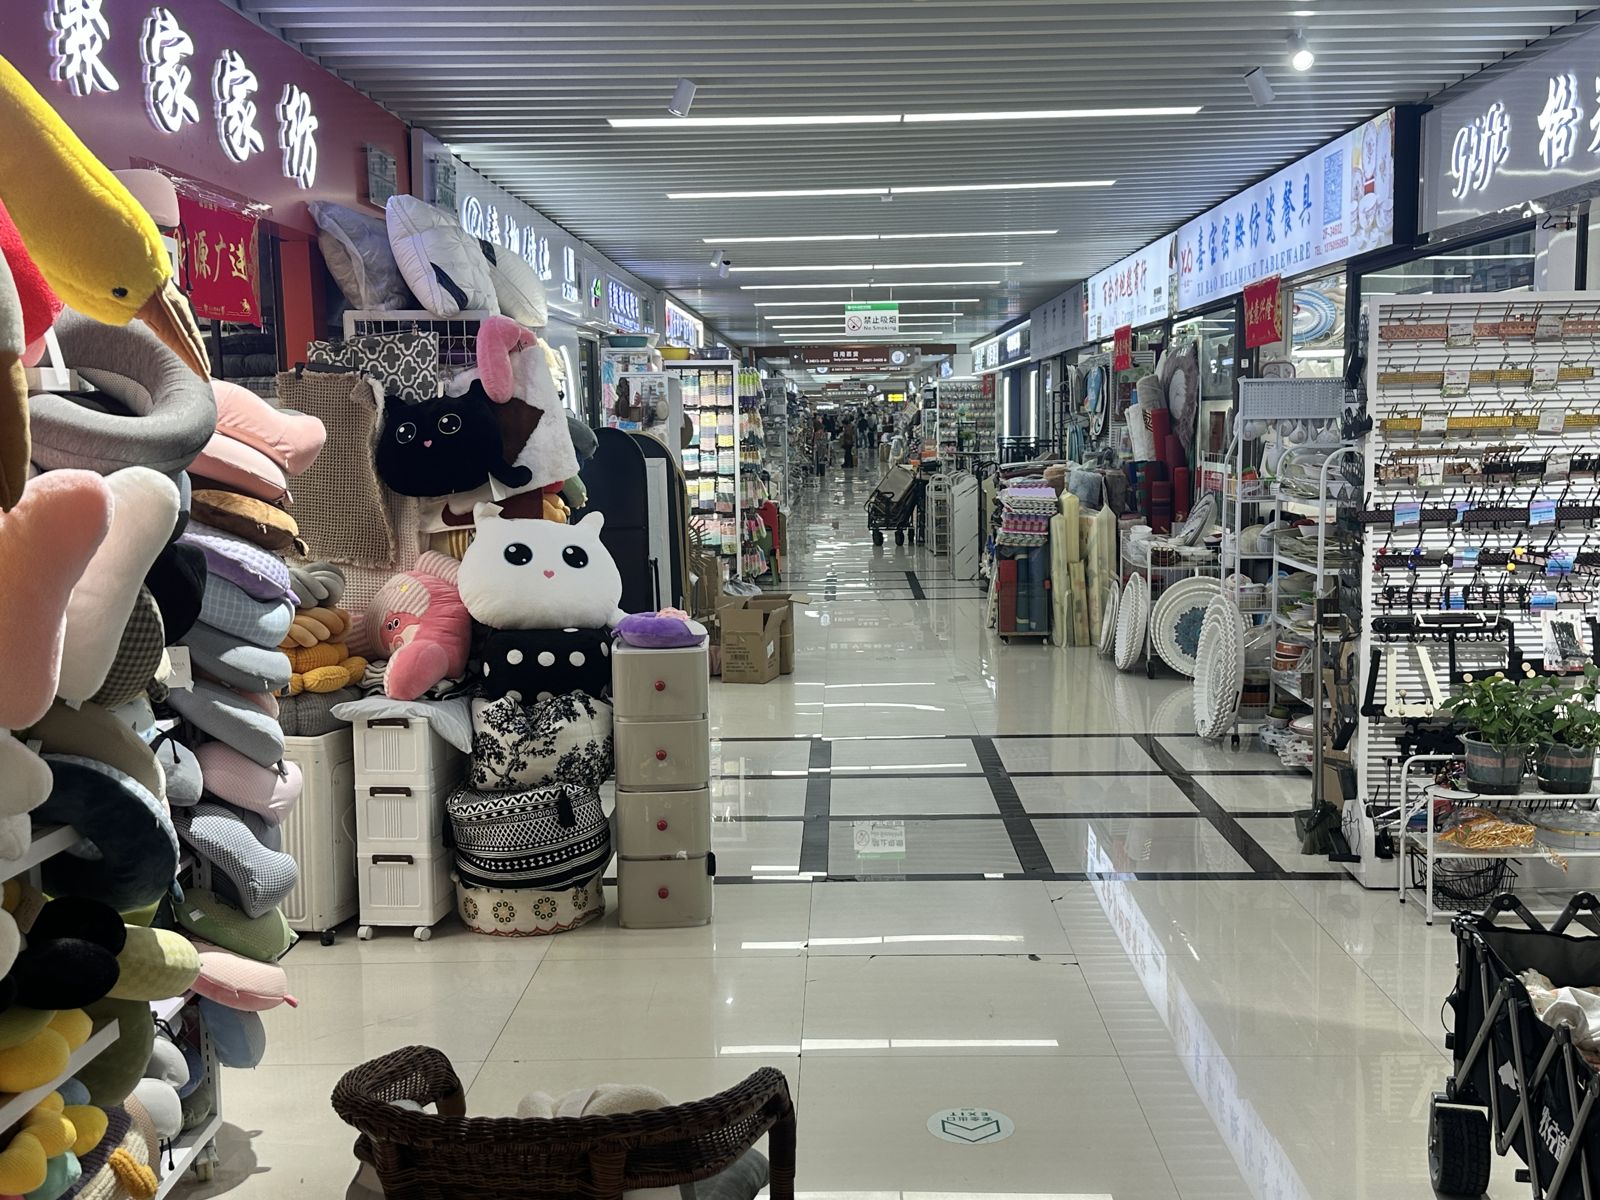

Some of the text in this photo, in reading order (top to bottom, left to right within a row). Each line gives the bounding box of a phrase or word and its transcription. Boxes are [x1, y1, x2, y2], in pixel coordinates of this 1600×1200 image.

[1452, 102, 1510, 199] Gift
[1205, 276, 1218, 294] BAO
[1220, 262, 1257, 289] MELAMINE
[1259, 240, 1311, 276] TABLEWARE
[864, 316, 896, 324] 禁止吸烟
